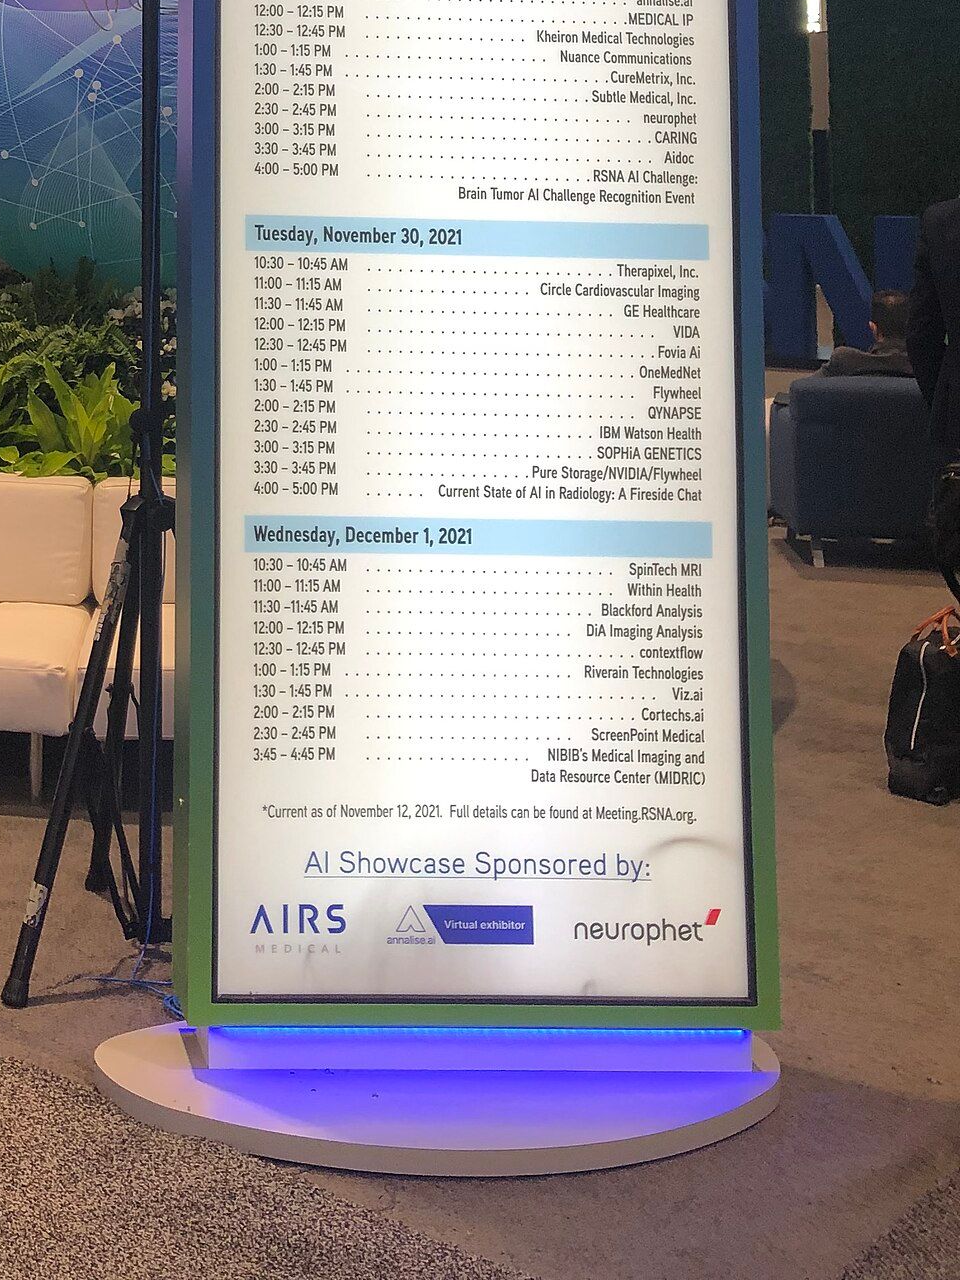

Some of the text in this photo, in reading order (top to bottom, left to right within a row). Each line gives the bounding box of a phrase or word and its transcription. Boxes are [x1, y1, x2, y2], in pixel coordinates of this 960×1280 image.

[537, 30, 694, 49] Kheiron Medical Technologies
[560, 50, 692, 65] Nuance Communications
[610, 71, 696, 87] CureMetrix, Inc.
[592, 90, 696, 106] Subtle Medical, Inc.
[644, 111, 696, 128] neurophet
[655, 131, 697, 144] CARING
[664, 151, 694, 164] Aidoc
[458, 186, 694, 206] Brain Tumor AI Challenge Recognition Event
[254, 225, 462, 248] Tuesday, November 30, 2021
[617, 264, 698, 281] Therapixel, Inc.
[540, 282, 700, 301] Circle Cardiovascular Imaging
[624, 304, 700, 318] GE Healthcare
[673, 325, 700, 338] VIDA
[639, 365, 701, 379] OneMedNet
[654, 386, 701, 403] Flywheel
[648, 406, 701, 420] QYNAPSE
[600, 426, 702, 440] IBM Watson Health
[597, 446, 702, 461] SOPHiA GENETICS
[438, 484, 702, 504] Current State of AI in Radiology: A Fireside Chat
[254, 525, 472, 547] Wednesday, December 1, 2021
[629, 562, 701, 580] SpinTech MRI
[628, 583, 702, 597] Within Health
[602, 603, 702, 622] Blackford Analysis
[586, 623, 703, 642] DiA Imaging Analysis
[640, 645, 703, 659] contextflow
[584, 665, 703, 683] Riverain Technologies
[672, 687, 703, 701] Viz.ai
[642, 707, 704, 722] Cortechs.ai
[592, 728, 705, 743] ScreenPoint Medical
[548, 747, 705, 767] NIBIB's Medical Imaging and
[532, 769, 705, 785] Data Resource Center (MIDRIC)
[311, 808, 323, 818] as
[326, 804, 337, 818] of
[340, 804, 394, 818] November
[397, 804, 411, 820] 12,
[415, 804, 442, 818] 2021.
[450, 804, 469, 818] Full
[473, 804, 508, 819] details
[511, 808, 530, 819] can
[534, 805, 546, 819] be
[550, 805, 578, 819] found
[582, 807, 592, 820] at
[596, 806, 697, 825] Meeting.RSNA.org.
[304, 851, 650, 883] AI Showcase Sponsored by:
[250, 904, 346, 934] AIRS
[444, 920, 525, 930] Virtual exhibitor
[387, 935, 436, 945] annalise.ai
[574, 918, 703, 946] neurophet
[255, 944, 342, 954] MEDICAL
